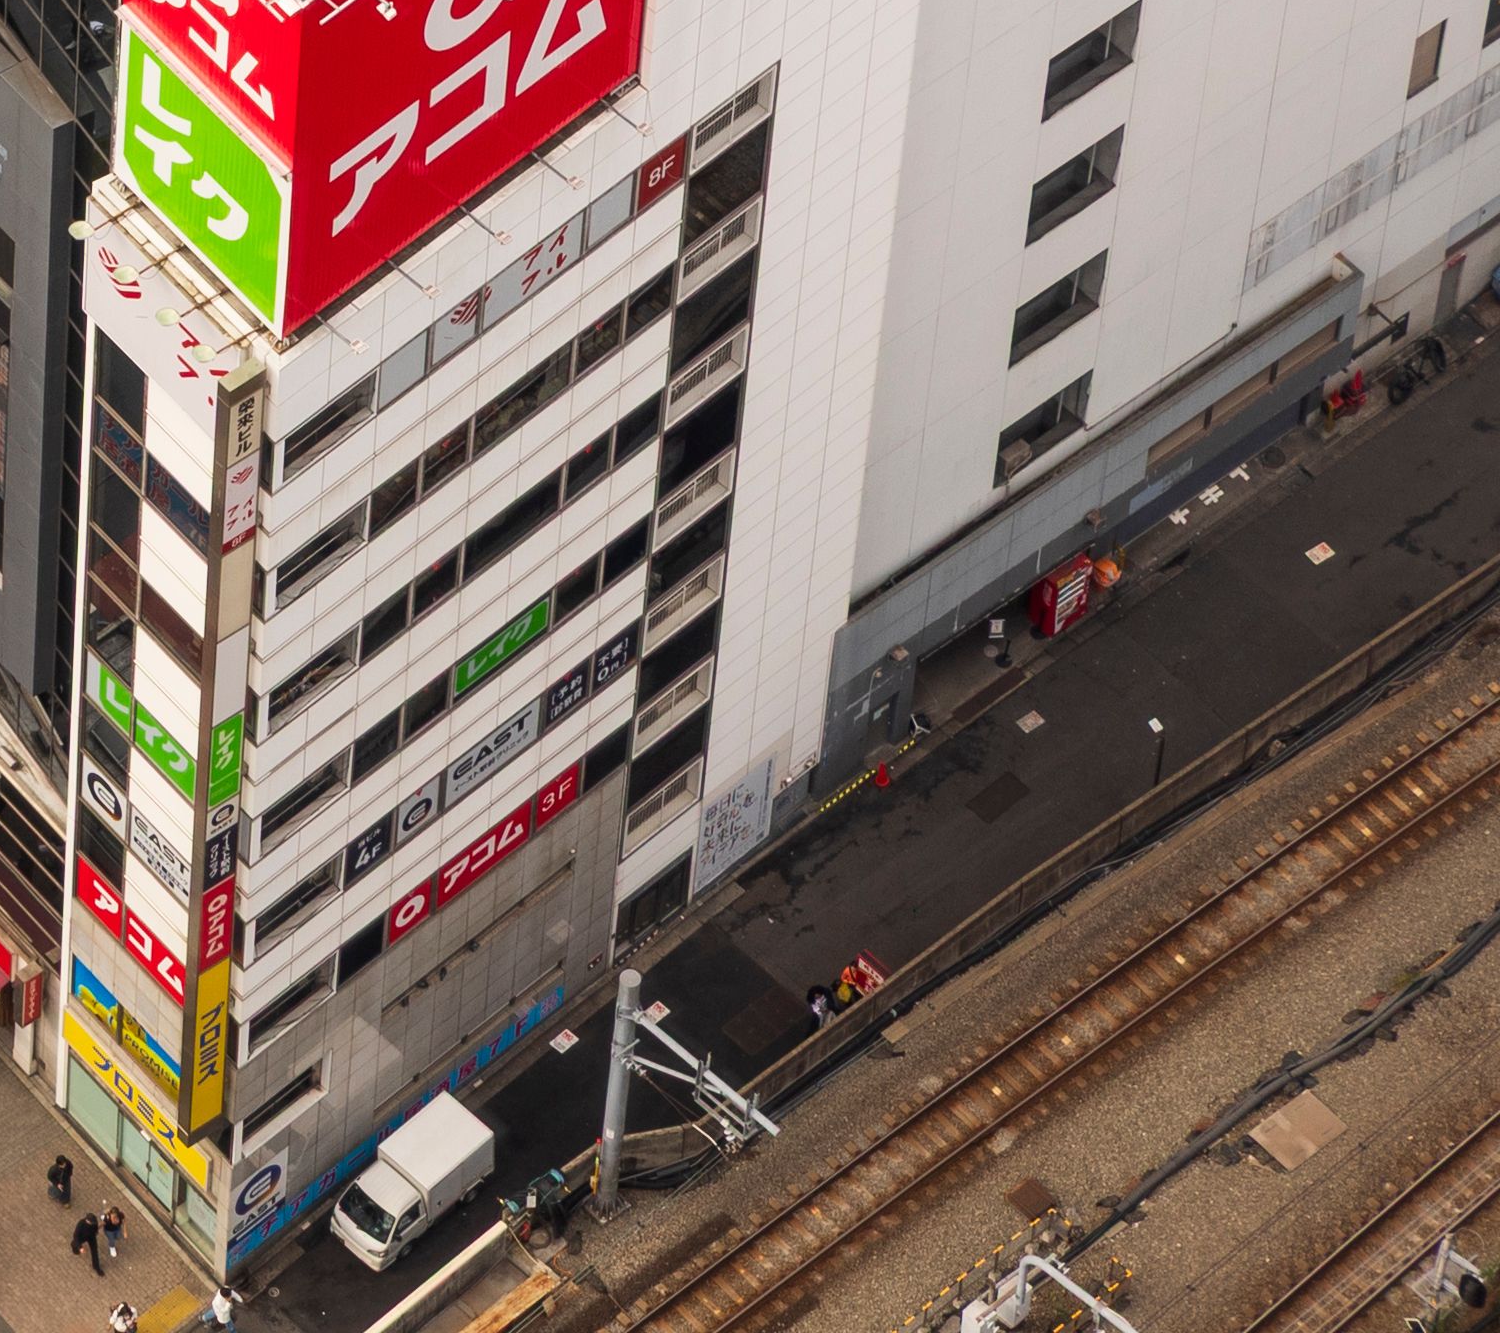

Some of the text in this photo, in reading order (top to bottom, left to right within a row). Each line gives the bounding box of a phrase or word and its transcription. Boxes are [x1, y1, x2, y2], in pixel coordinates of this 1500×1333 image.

[132, 53, 252, 243] レイク
[648, 154, 676, 189] 8F
[466, 613, 534, 680] レイク
[105, 675, 191, 774] レイク
[216, 729, 236, 772] レイク
[452, 709, 534, 782] EAST
[541, 774, 574, 814] 3F
[133, 813, 192, 879] EAST
[354, 845, 382, 871] 4F
[443, 820, 525, 894] アコム
[92, 878, 186, 997] アコム
[122, 1032, 179, 1091] PROMISE
[198, 1001, 226, 1086] プロミス
[92, 1045, 178, 1151] プロミス
[233, 1192, 280, 1234] EAST
